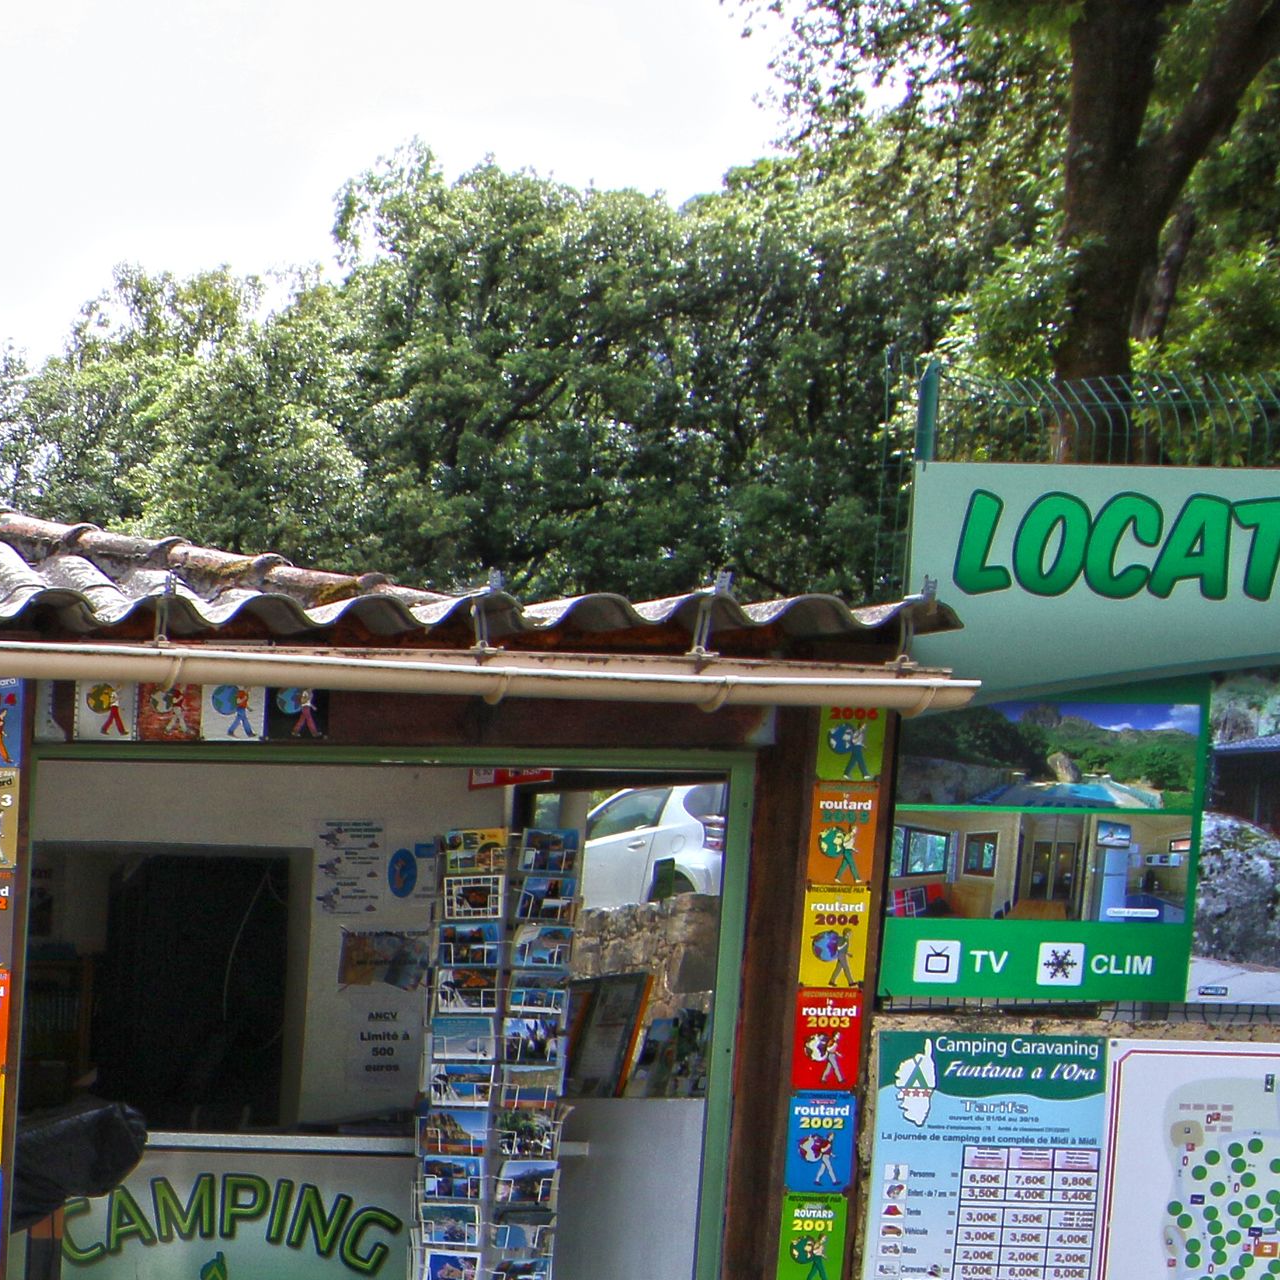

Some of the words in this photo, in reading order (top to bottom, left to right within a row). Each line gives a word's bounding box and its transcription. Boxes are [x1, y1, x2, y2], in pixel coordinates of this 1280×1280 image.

[830, 707, 878, 719] 2006
[819, 799, 872, 811] routard
[811, 901, 863, 913] routard
[815, 914, 859, 925] 2004
[969, 950, 1008, 974] TV
[1091, 955, 1152, 976] CLIM
[368, 1012, 398, 1020] ANCV
[802, 1005, 856, 1017] routard
[807, 1017, 850, 1028] 2003
[360, 1032, 398, 1041] Limité
[402, 1031, 410, 1040] à
[372, 1047, 394, 1056] 500
[936, 1036, 1007, 1057] Camping
[1011, 1038, 1099, 1059] Caravaning
[365, 1064, 399, 1072] euros
[944, 1061, 1023, 1079] Funtana
[1031, 1068, 1041, 1079] a
[1050, 1063, 1097, 1080] l'Ora
[794, 1105, 850, 1116] routard
[960, 1100, 1028, 1114] Tarifs
[800, 1117, 844, 1129] 2002
[942, 1134, 979, 1143] camping
[969, 1174, 1000, 1184] 6,50€
[1061, 1177, 1092, 1187] 9,80€
[968, 1188, 998, 1198] 3,50€
[1014, 1189, 1045, 1199] 4,00€
[793, 1209, 834, 1219] ROUTARD
[61, 1172, 402, 1277] CAMPING
[793, 1220, 833, 1231] 2001
